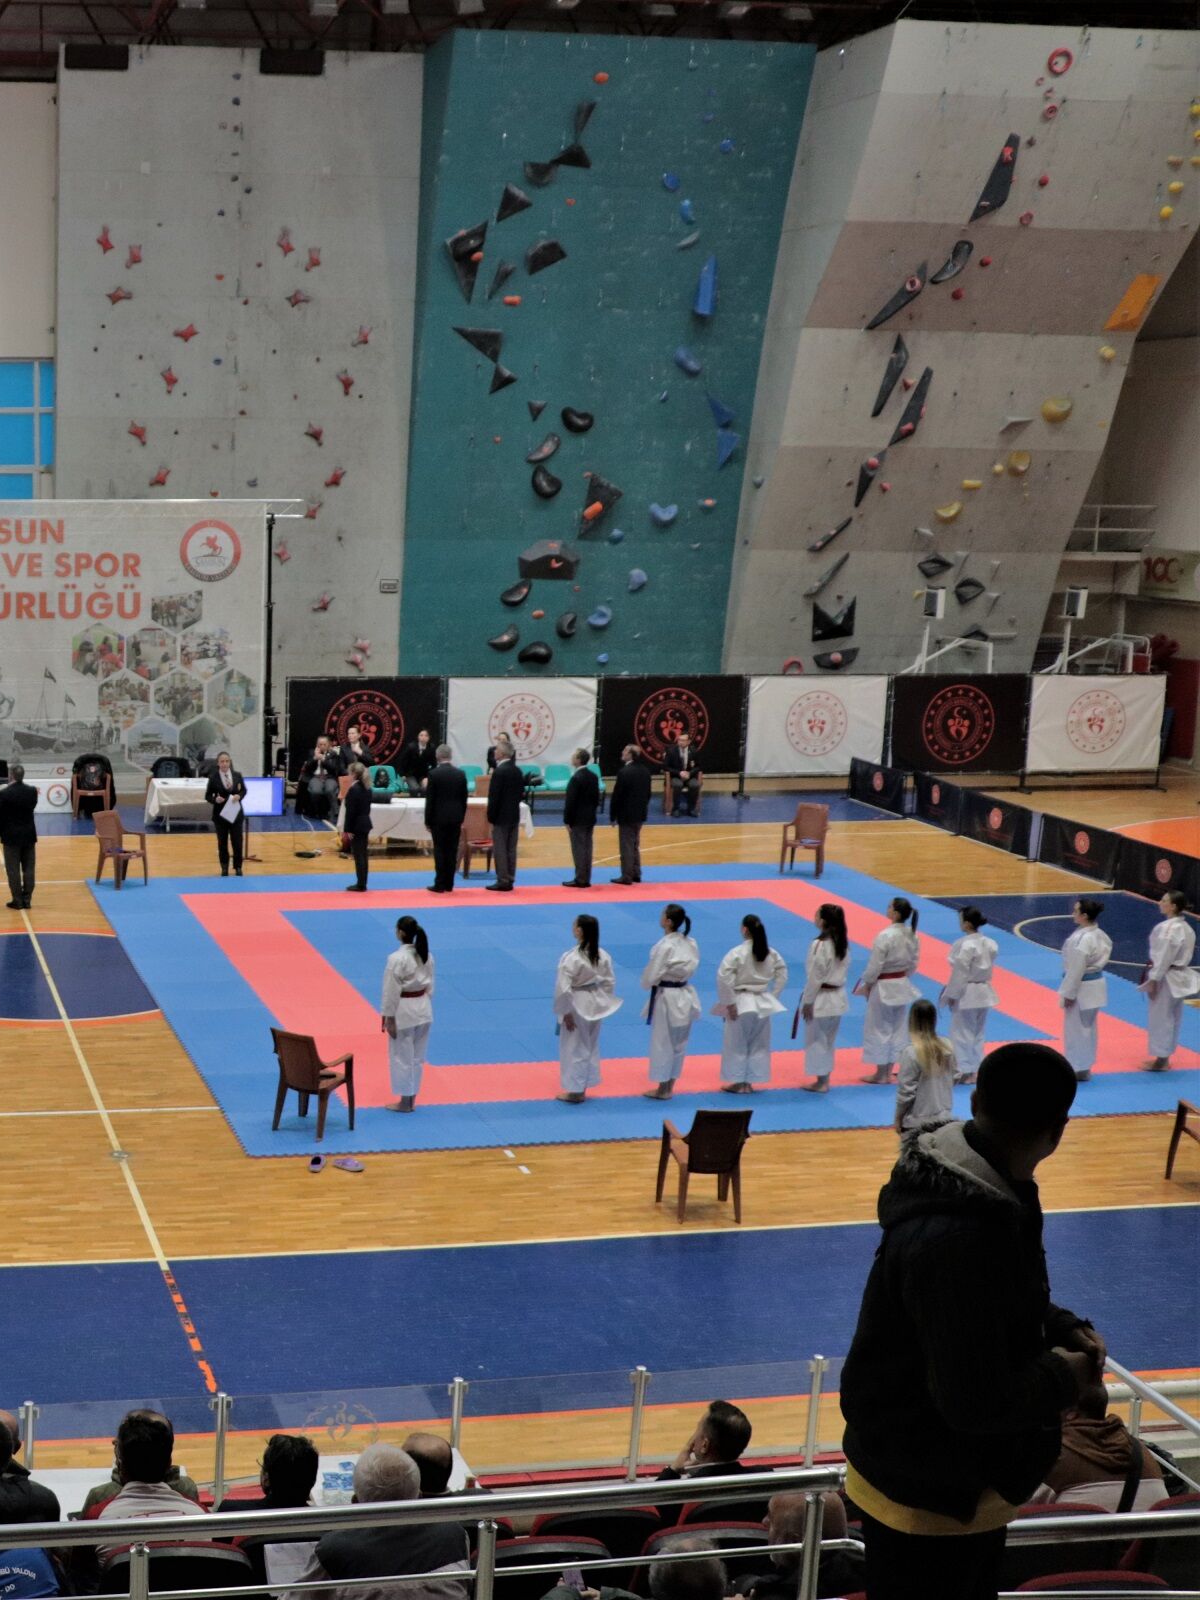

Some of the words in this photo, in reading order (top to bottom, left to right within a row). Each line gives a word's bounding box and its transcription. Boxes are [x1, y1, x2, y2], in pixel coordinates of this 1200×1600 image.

[1, 552, 43, 578] VE
[54, 551, 142, 578] SPOR
[12, 1567, 36, 1579] YALOVA
